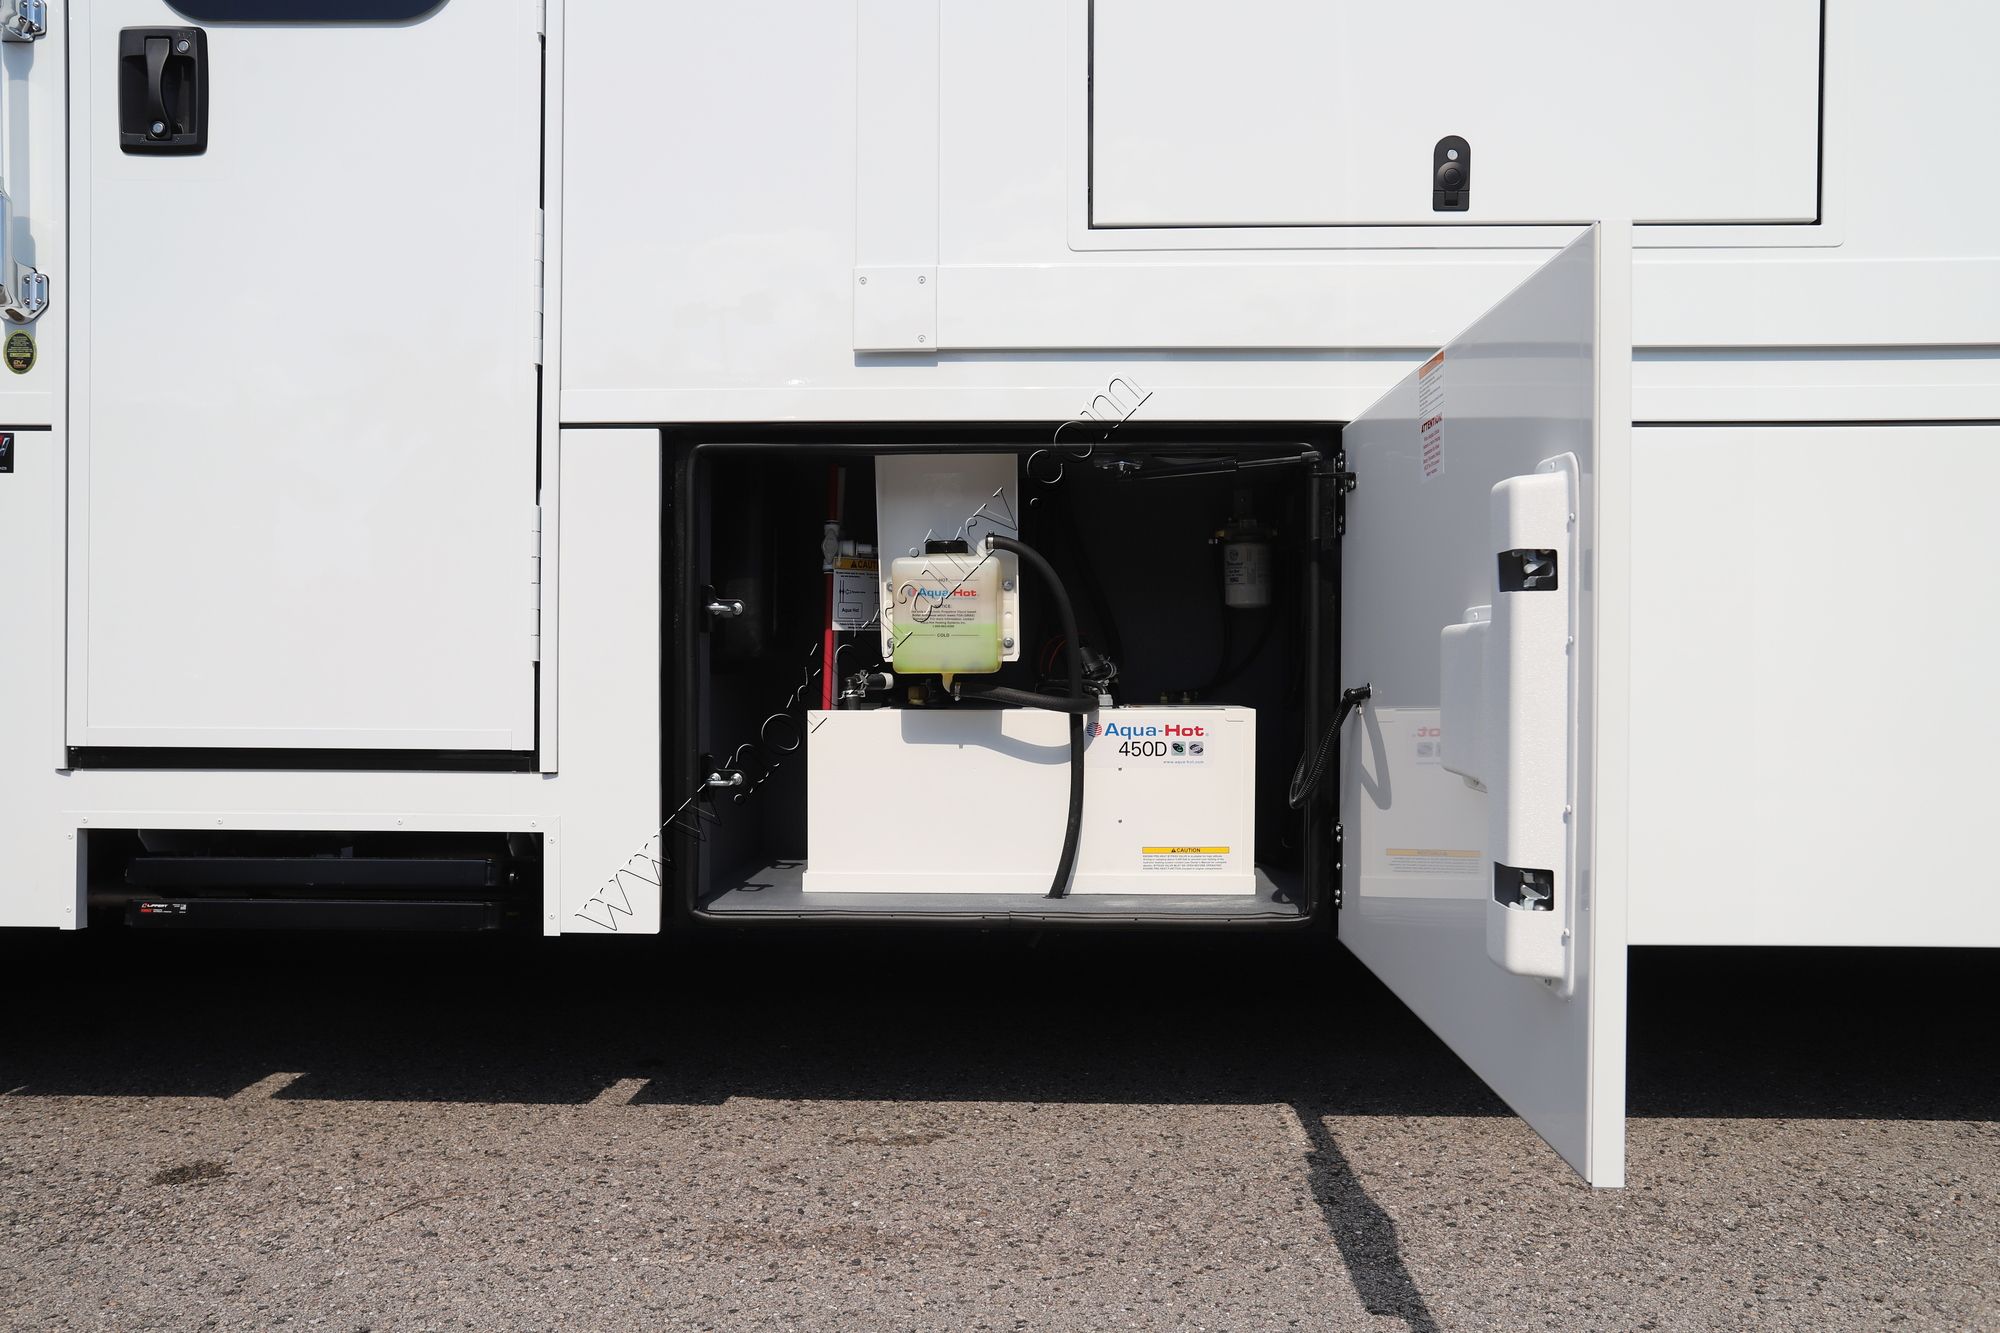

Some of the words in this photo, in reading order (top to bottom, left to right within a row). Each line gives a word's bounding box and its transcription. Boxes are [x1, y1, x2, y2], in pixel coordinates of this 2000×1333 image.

[919, 587, 977, 598] AquaHot
[1104, 722, 1205, 740] Aqua-Hot
[1118, 741, 1167, 757] 450D
